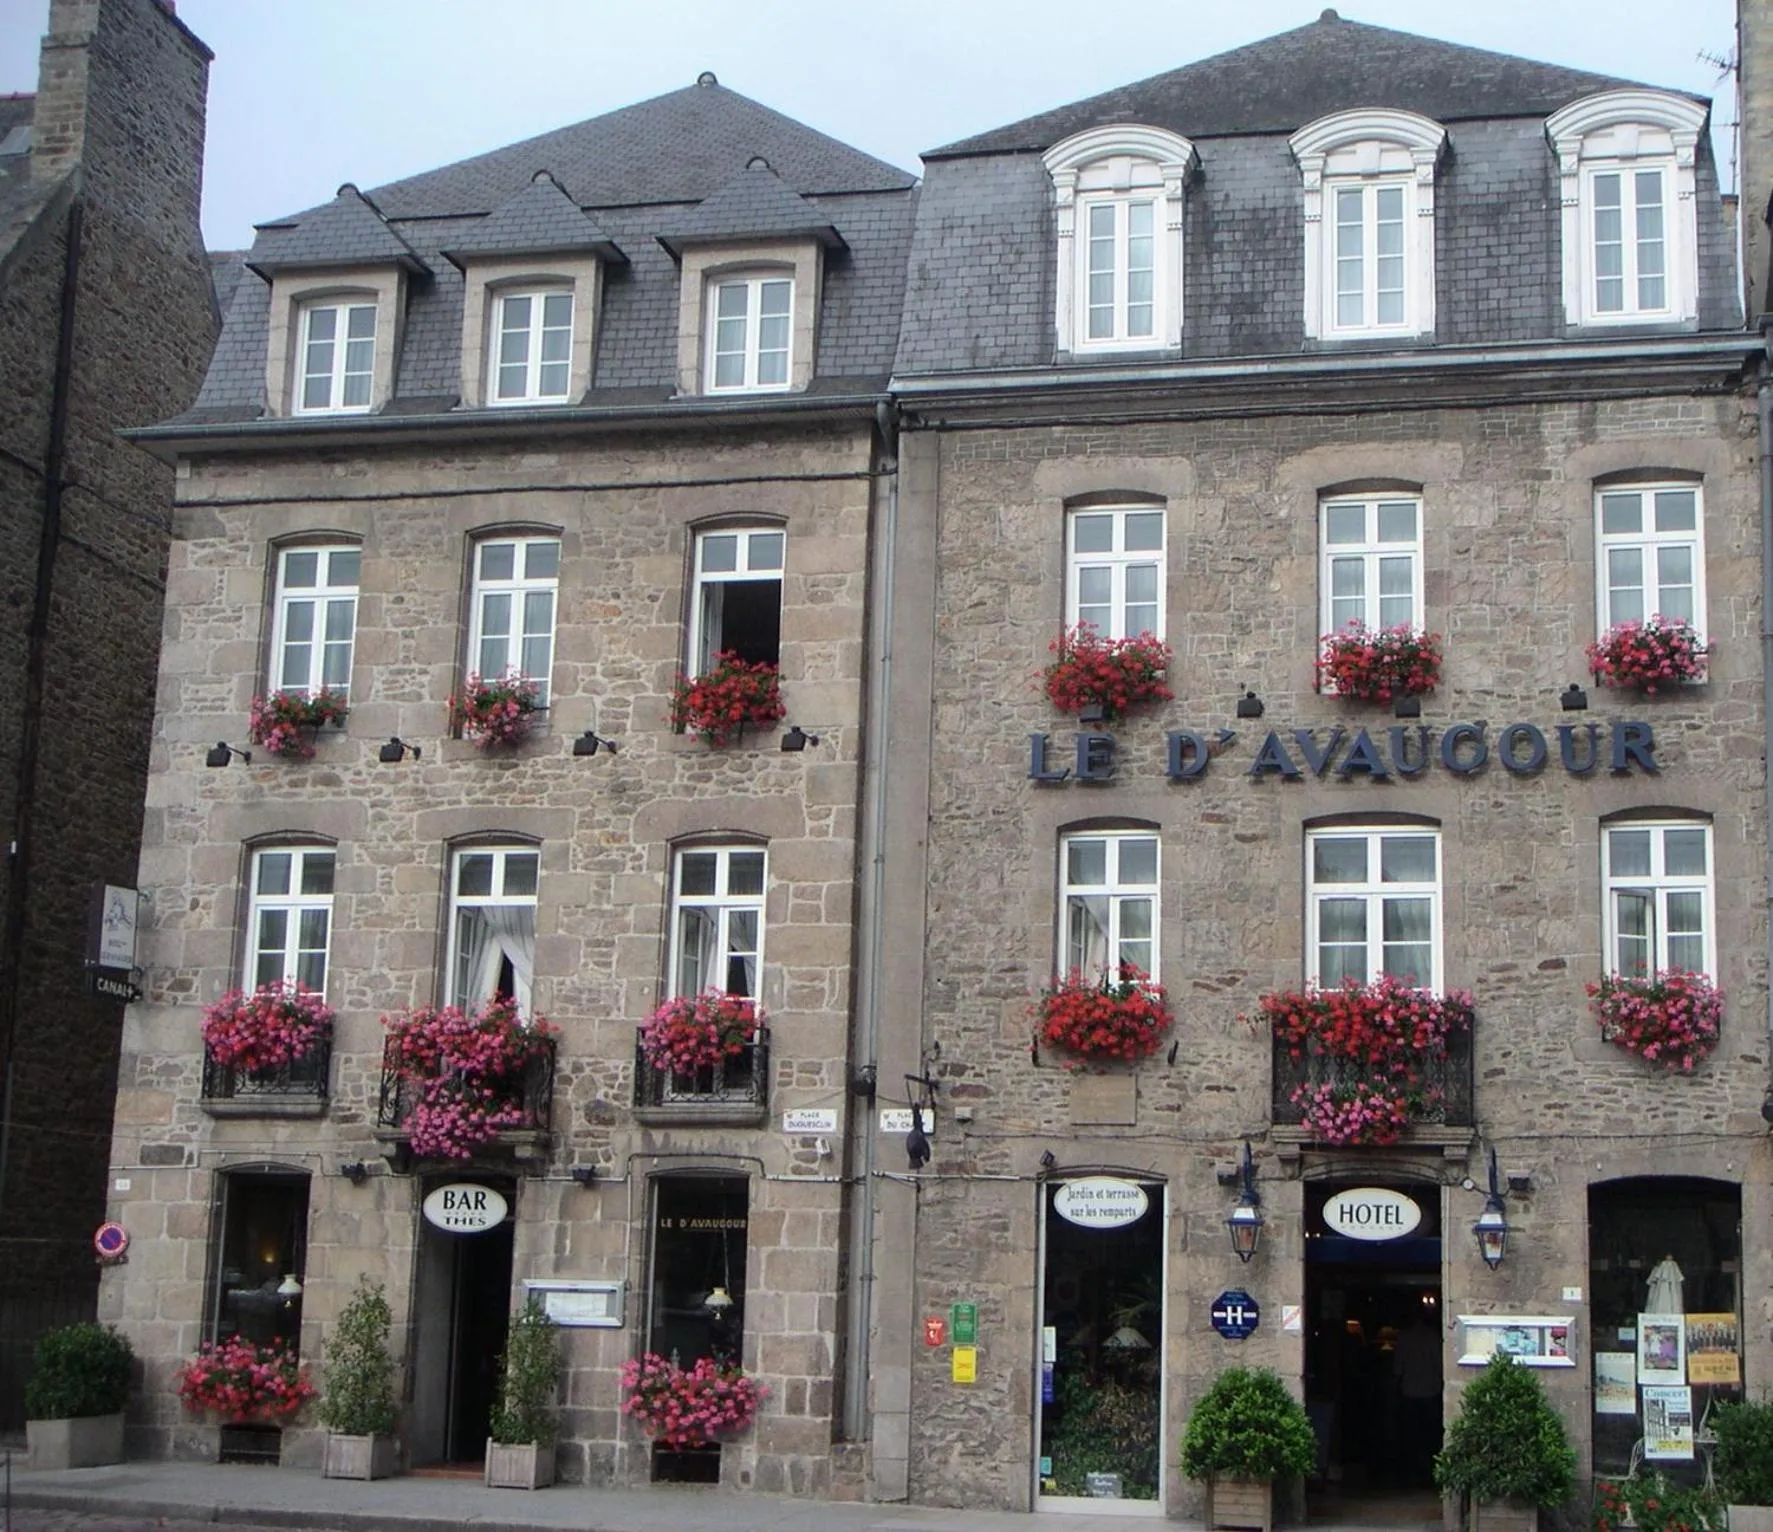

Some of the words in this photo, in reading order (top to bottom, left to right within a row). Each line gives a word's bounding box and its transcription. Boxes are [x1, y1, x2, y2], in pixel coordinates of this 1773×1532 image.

[1027, 732, 1117, 781] LE
[1164, 720, 1660, 783] D'AVAUGOUR
[443, 1190, 487, 1210] BAR
[1067, 1184, 1094, 1202] Jardin
[661, 1218, 672, 1228] LE
[1340, 1203, 1404, 1225] HOTEL
[1226, 1305, 1243, 1325] H
